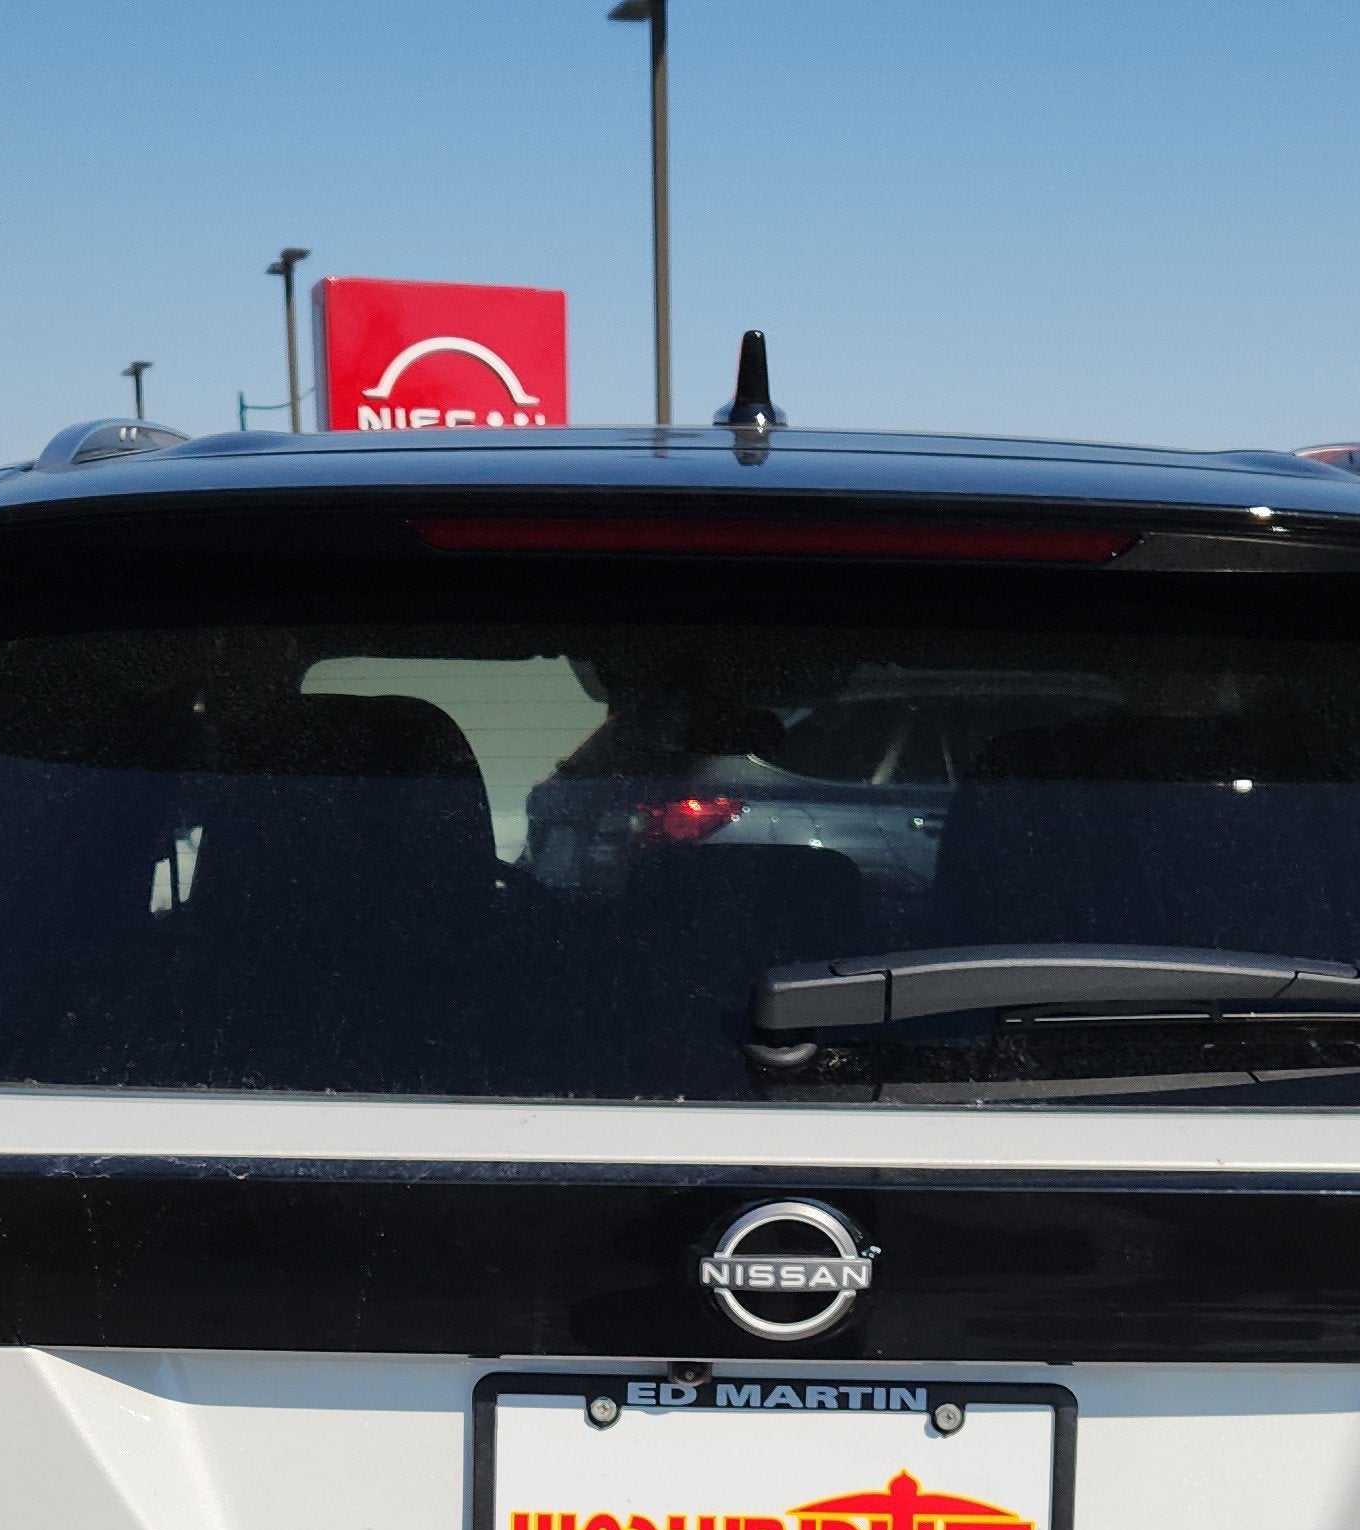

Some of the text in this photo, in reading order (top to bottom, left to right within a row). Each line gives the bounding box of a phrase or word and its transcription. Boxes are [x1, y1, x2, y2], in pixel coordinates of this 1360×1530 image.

[701, 1260, 870, 1288] NISSAN
[627, 1381, 927, 1411] ED MARTIN
